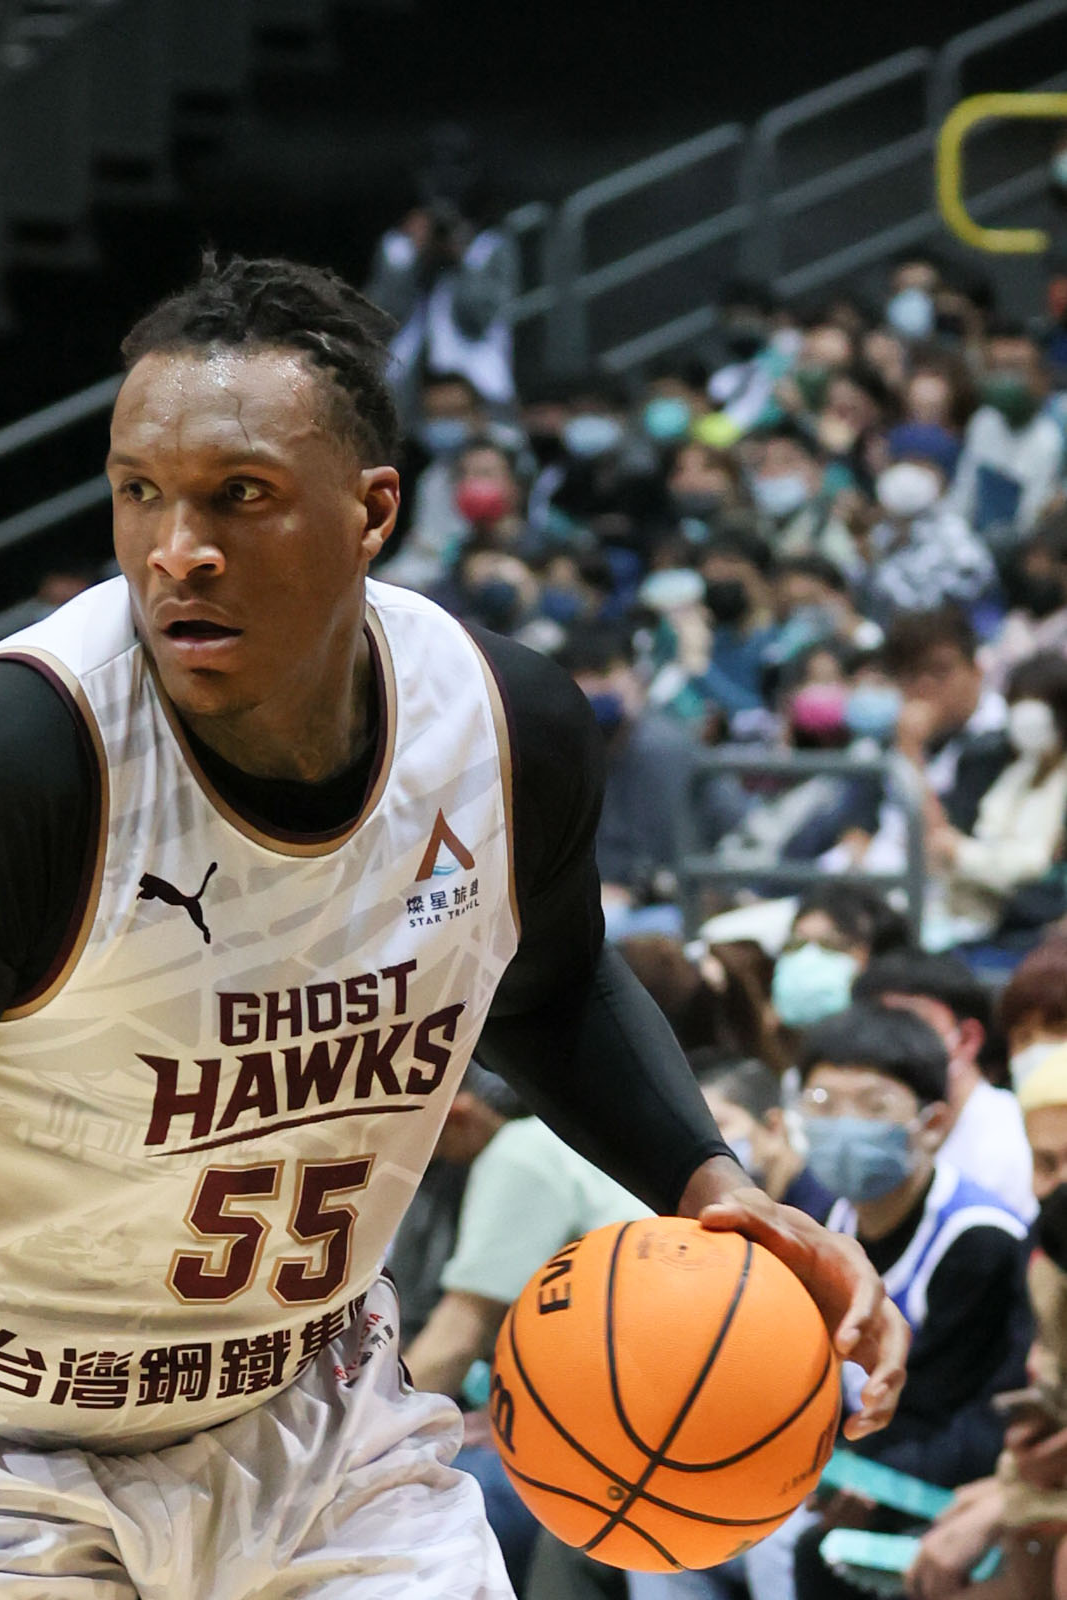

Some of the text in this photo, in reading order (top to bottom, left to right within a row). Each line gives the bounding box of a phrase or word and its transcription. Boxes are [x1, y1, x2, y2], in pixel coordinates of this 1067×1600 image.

[409, 899, 480, 928] STAR TRAVEL
[215, 959, 419, 1048] GHOST
[135, 1000, 468, 1146] HAWKS
[164, 1153, 377, 1308] 55
